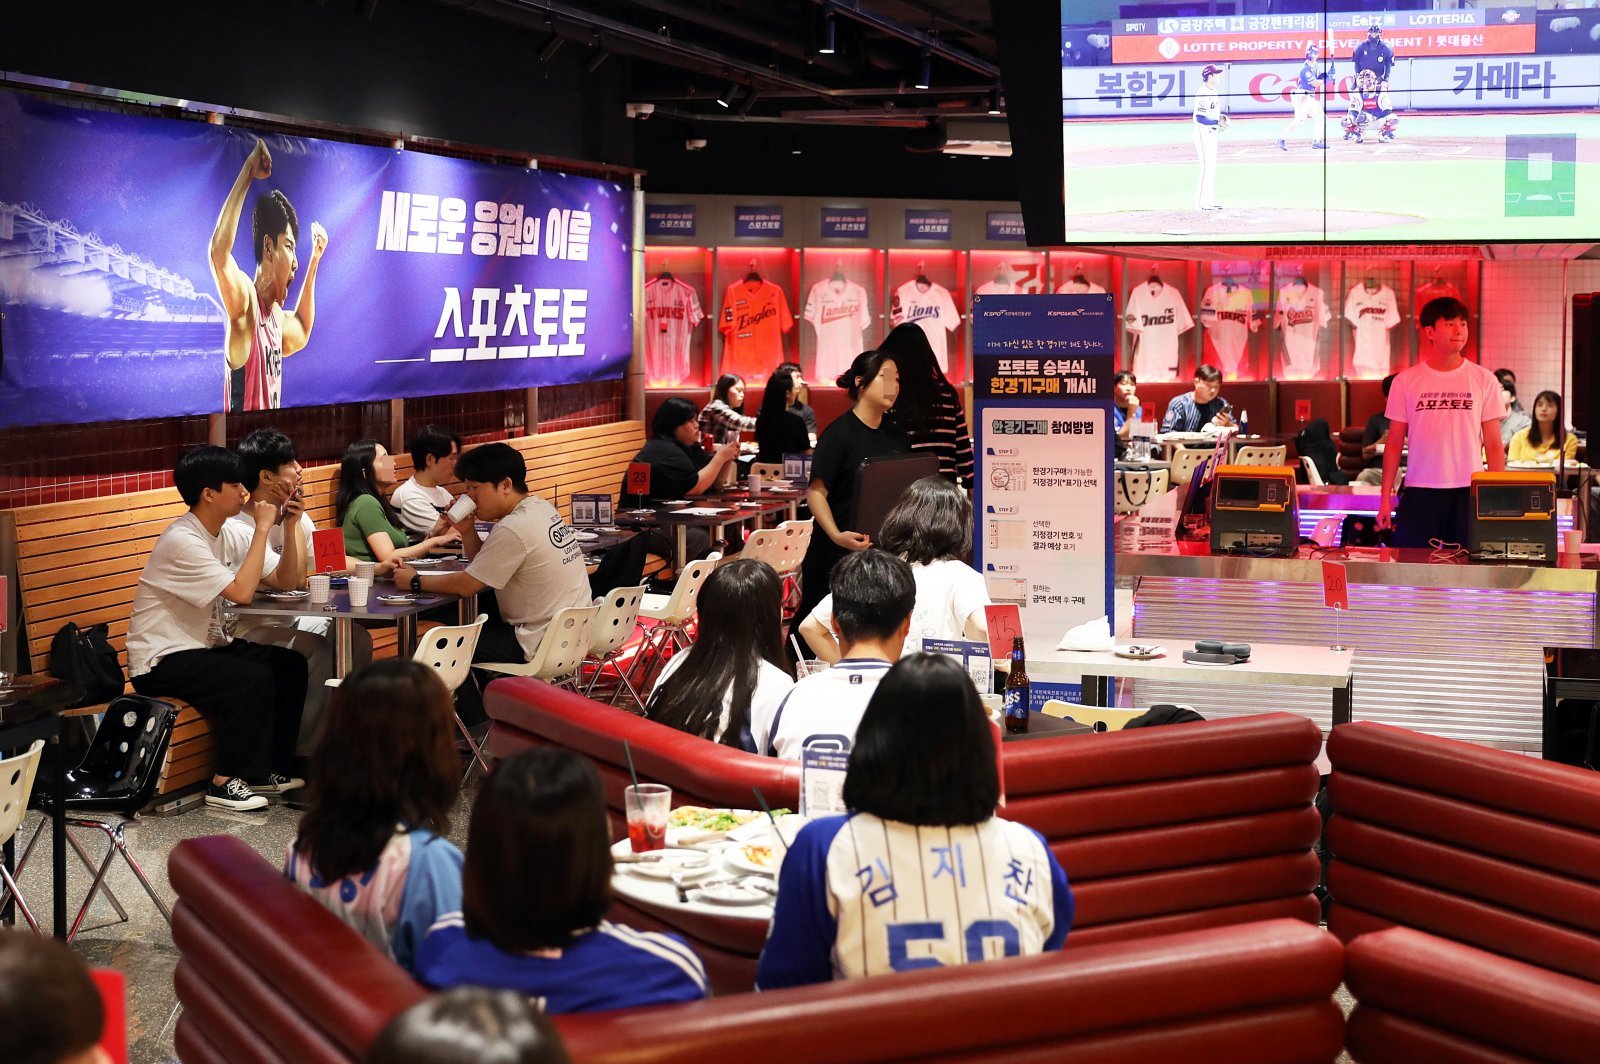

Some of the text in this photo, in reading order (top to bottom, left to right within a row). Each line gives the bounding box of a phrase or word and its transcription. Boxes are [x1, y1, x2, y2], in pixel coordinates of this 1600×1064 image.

[1409, 13, 1475, 25] LOTTERIA
[1125, 23, 1146, 32] SPOTV
[1183, 42, 1224, 53] LOTTE
[1229, 39, 1303, 52] PROPERTY
[1453, 61, 1556, 100] 카메라
[1095, 70, 1186, 108] 복합기
[375, 190, 592, 261] 새로운 응원의 이름
[736, 303, 778, 331] Eagles
[906, 304, 940, 320] Lions
[429, 283, 588, 363] 스포츠토토
[1003, 339, 1019, 349] 자신
[1036, 339, 1044, 349] 한
[998, 359, 1089, 377] 프로토 승부식,
[990, 377, 1097, 394] 한경기구매 개시!
[1415, 399, 1474, 412] 스포츠토토
[992, 419, 1094, 435] 한경기구매 참여방법
[632, 471, 647, 484] 23
[1032, 467, 1093, 476] 한경기구매가 가능한
[1083, 479, 1098, 488] 선택
[1032, 520, 1051, 528] 선택한
[1032, 530, 1060, 540] 지정경기
[1061, 530, 1075, 540] 번호
[319, 542, 340, 558] 21
[1032, 541, 1076, 551] 결과 예상 표기
[1032, 584, 1051, 592] 원하는
[1327, 575, 1343, 592] 20
[1032, 594, 1047, 604] 금액
[1047, 595, 1062, 604] 선택
[1070, 596, 1086, 605] 구매
[990, 615, 1016, 642] 15
[855, 842, 1033, 907] 김지찬
